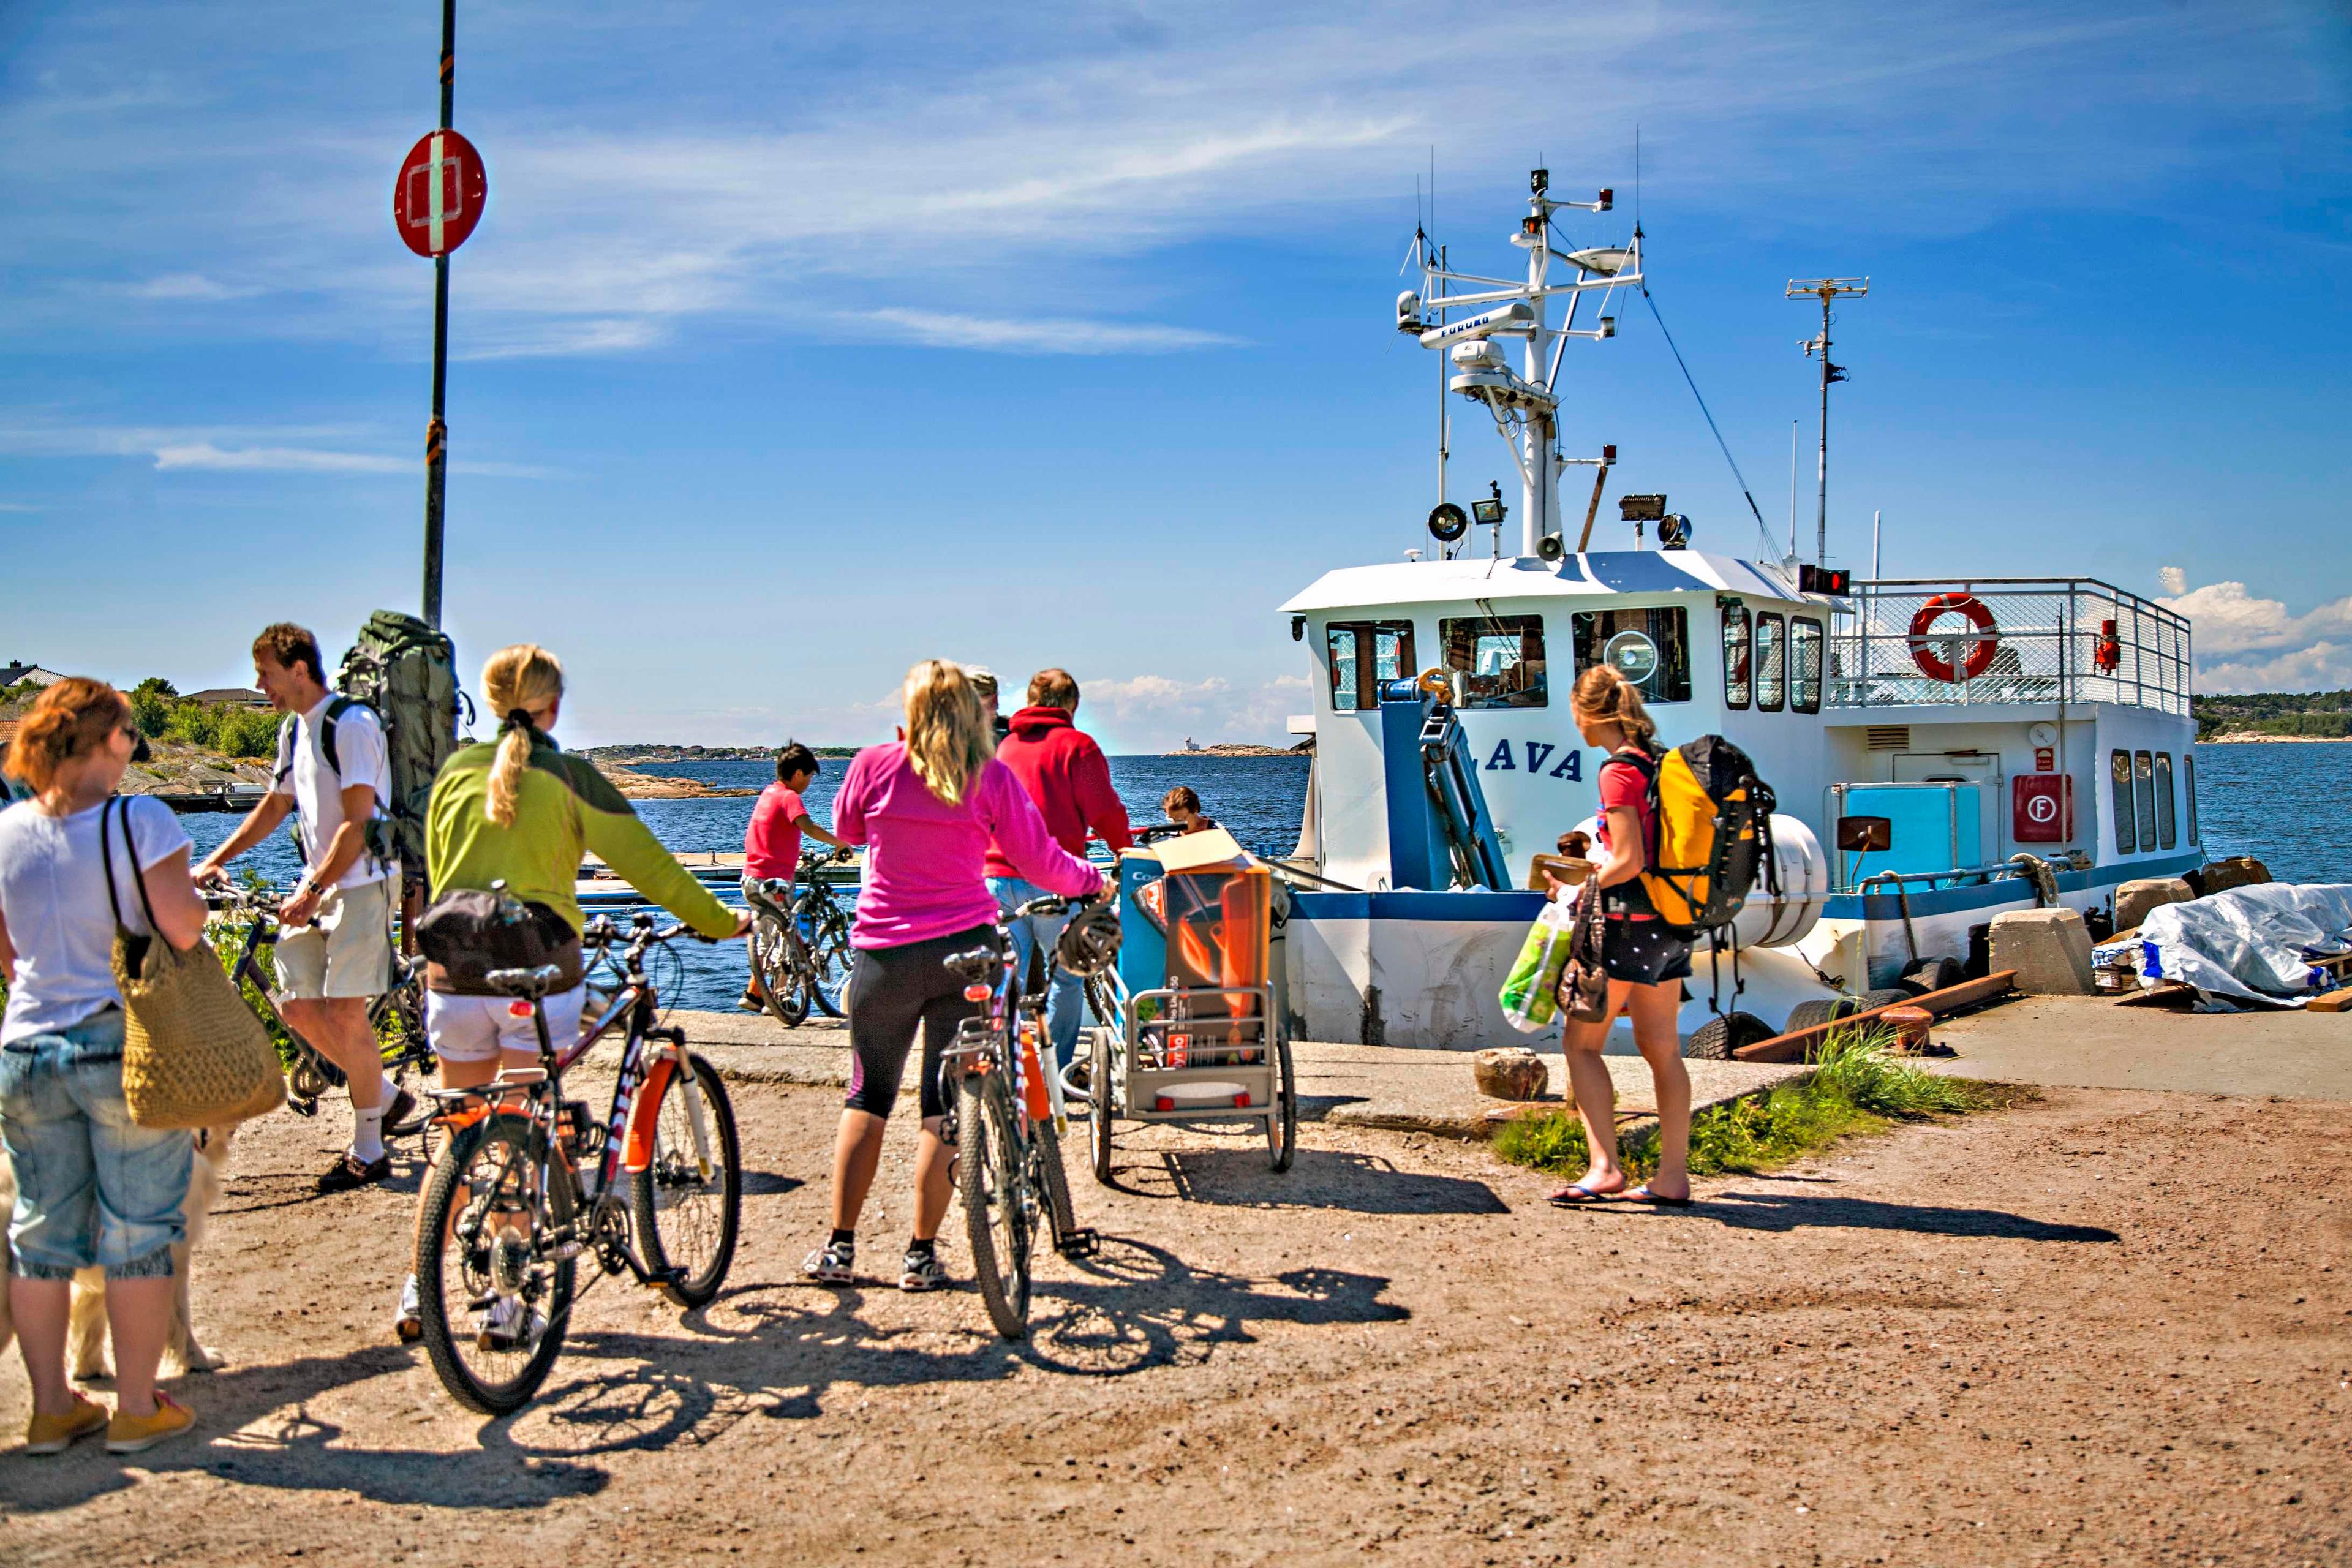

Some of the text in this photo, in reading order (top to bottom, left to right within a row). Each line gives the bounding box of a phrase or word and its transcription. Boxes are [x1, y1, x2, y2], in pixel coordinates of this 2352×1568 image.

[1472, 739, 1583, 783] AVA
[2037, 799, 2047, 818] F
[1148, 884, 1159, 914] Fly
